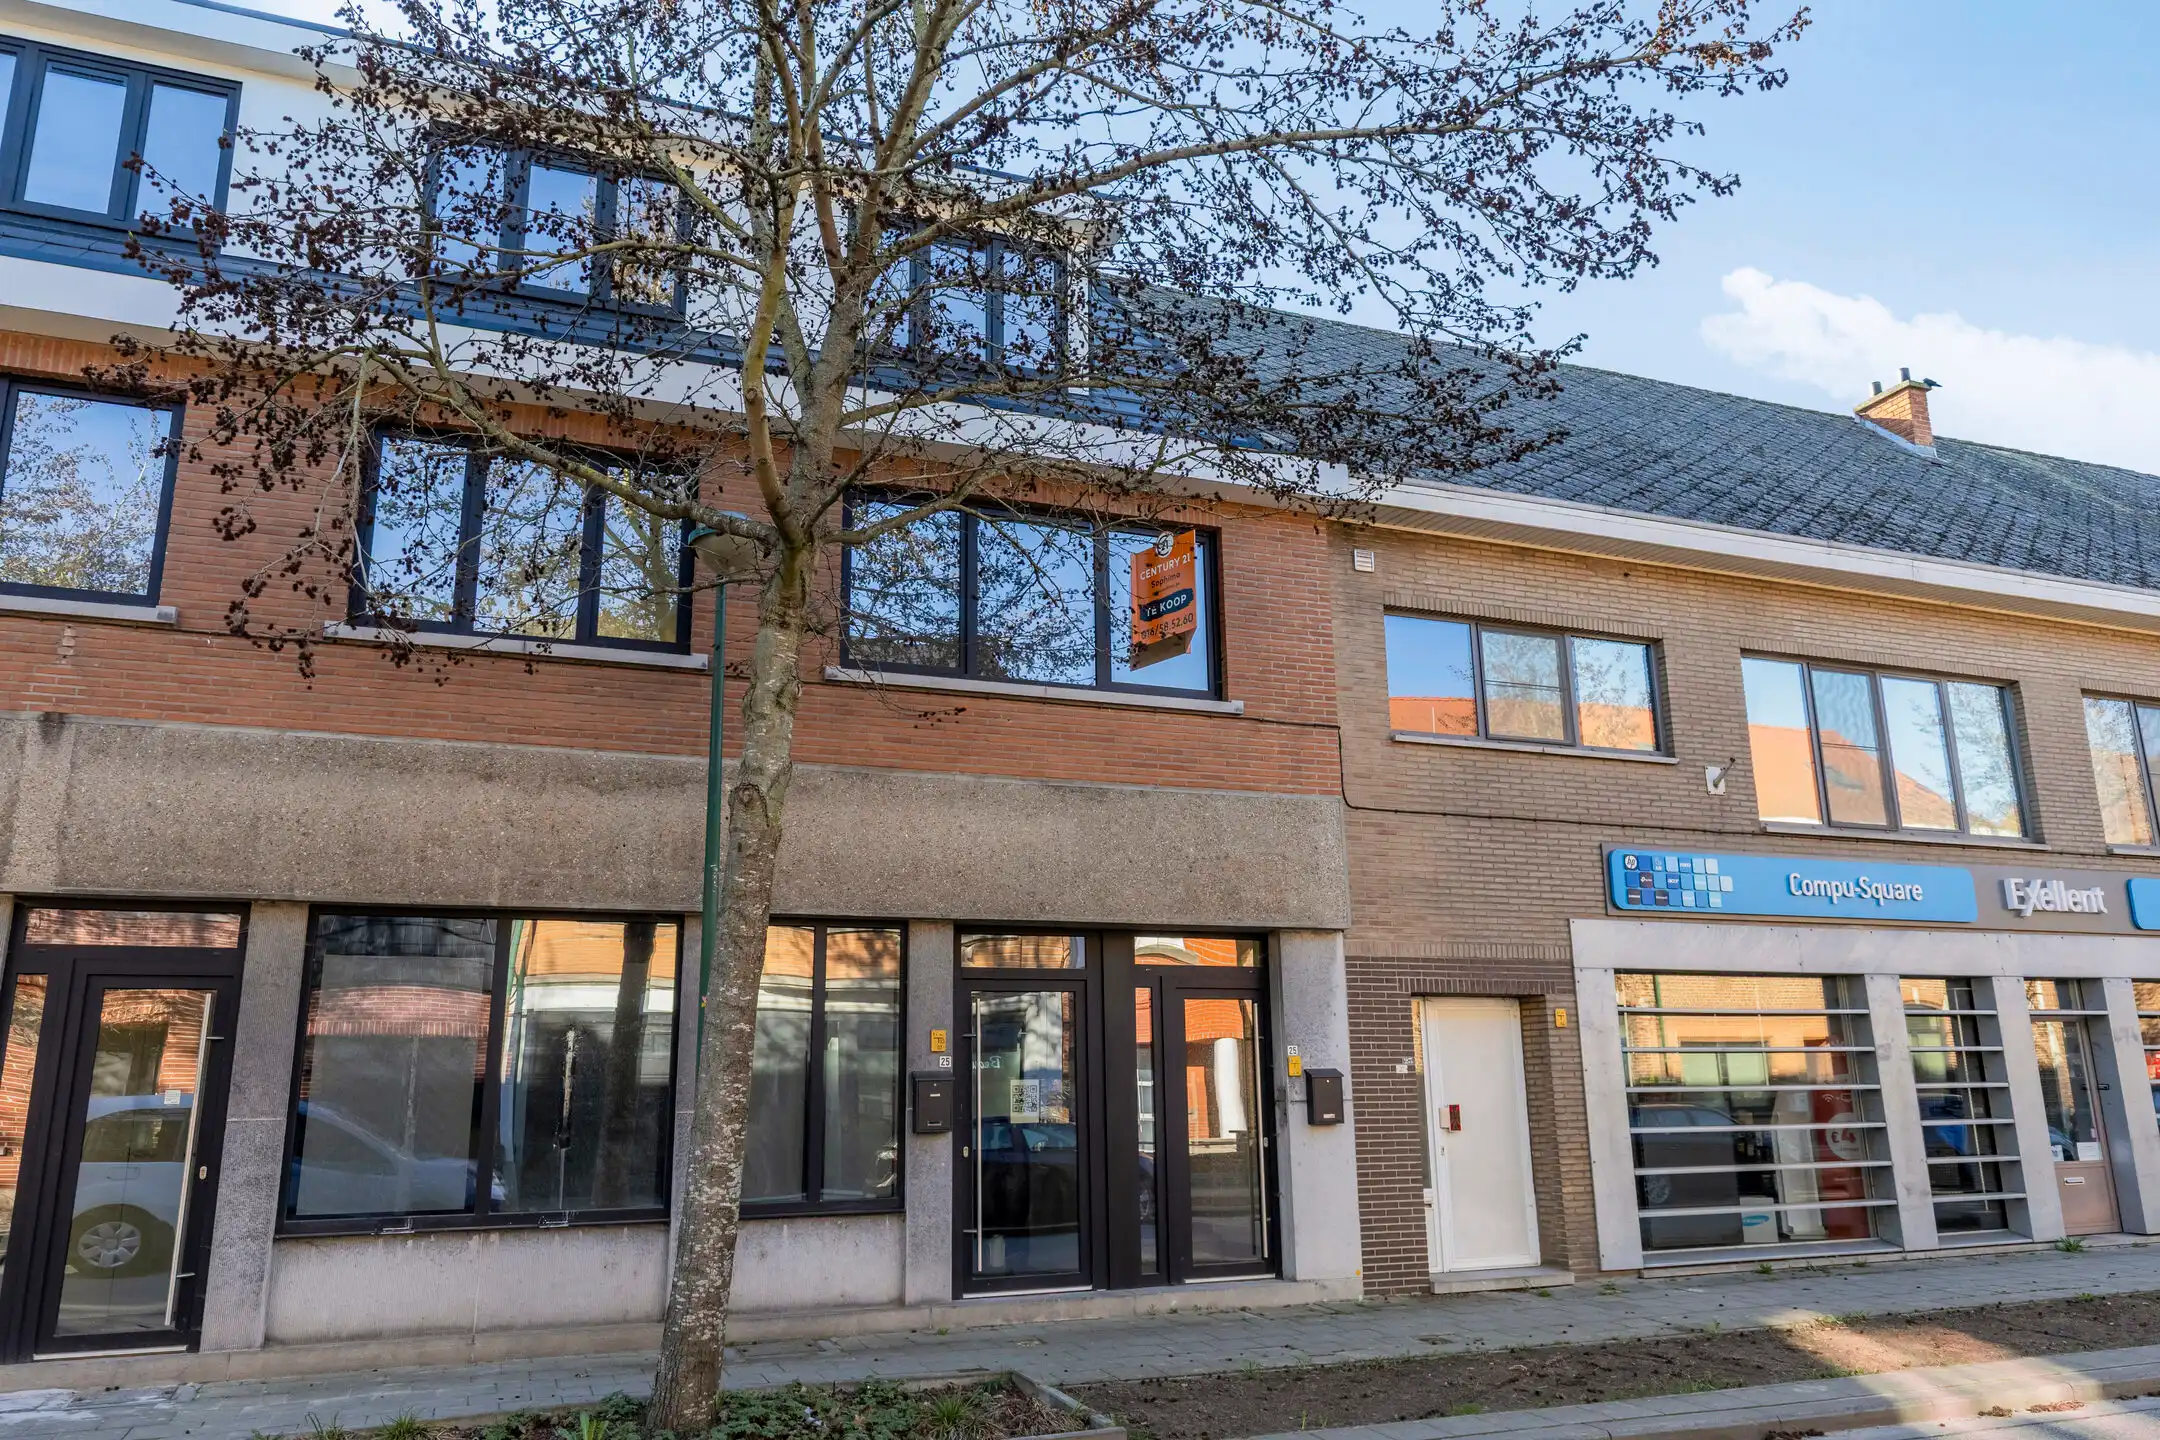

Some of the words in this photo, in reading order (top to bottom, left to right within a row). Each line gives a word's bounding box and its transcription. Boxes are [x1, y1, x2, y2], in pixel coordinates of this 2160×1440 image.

[1140, 557, 1180, 580] CENTURY
[1182, 552, 1191, 564] 21
[1160, 594, 1187, 612] KOOP
[1788, 872, 1923, 906] Compu-Square
[1289, 1047, 1297, 1055] 25
[940, 1057, 950, 1066] 25
